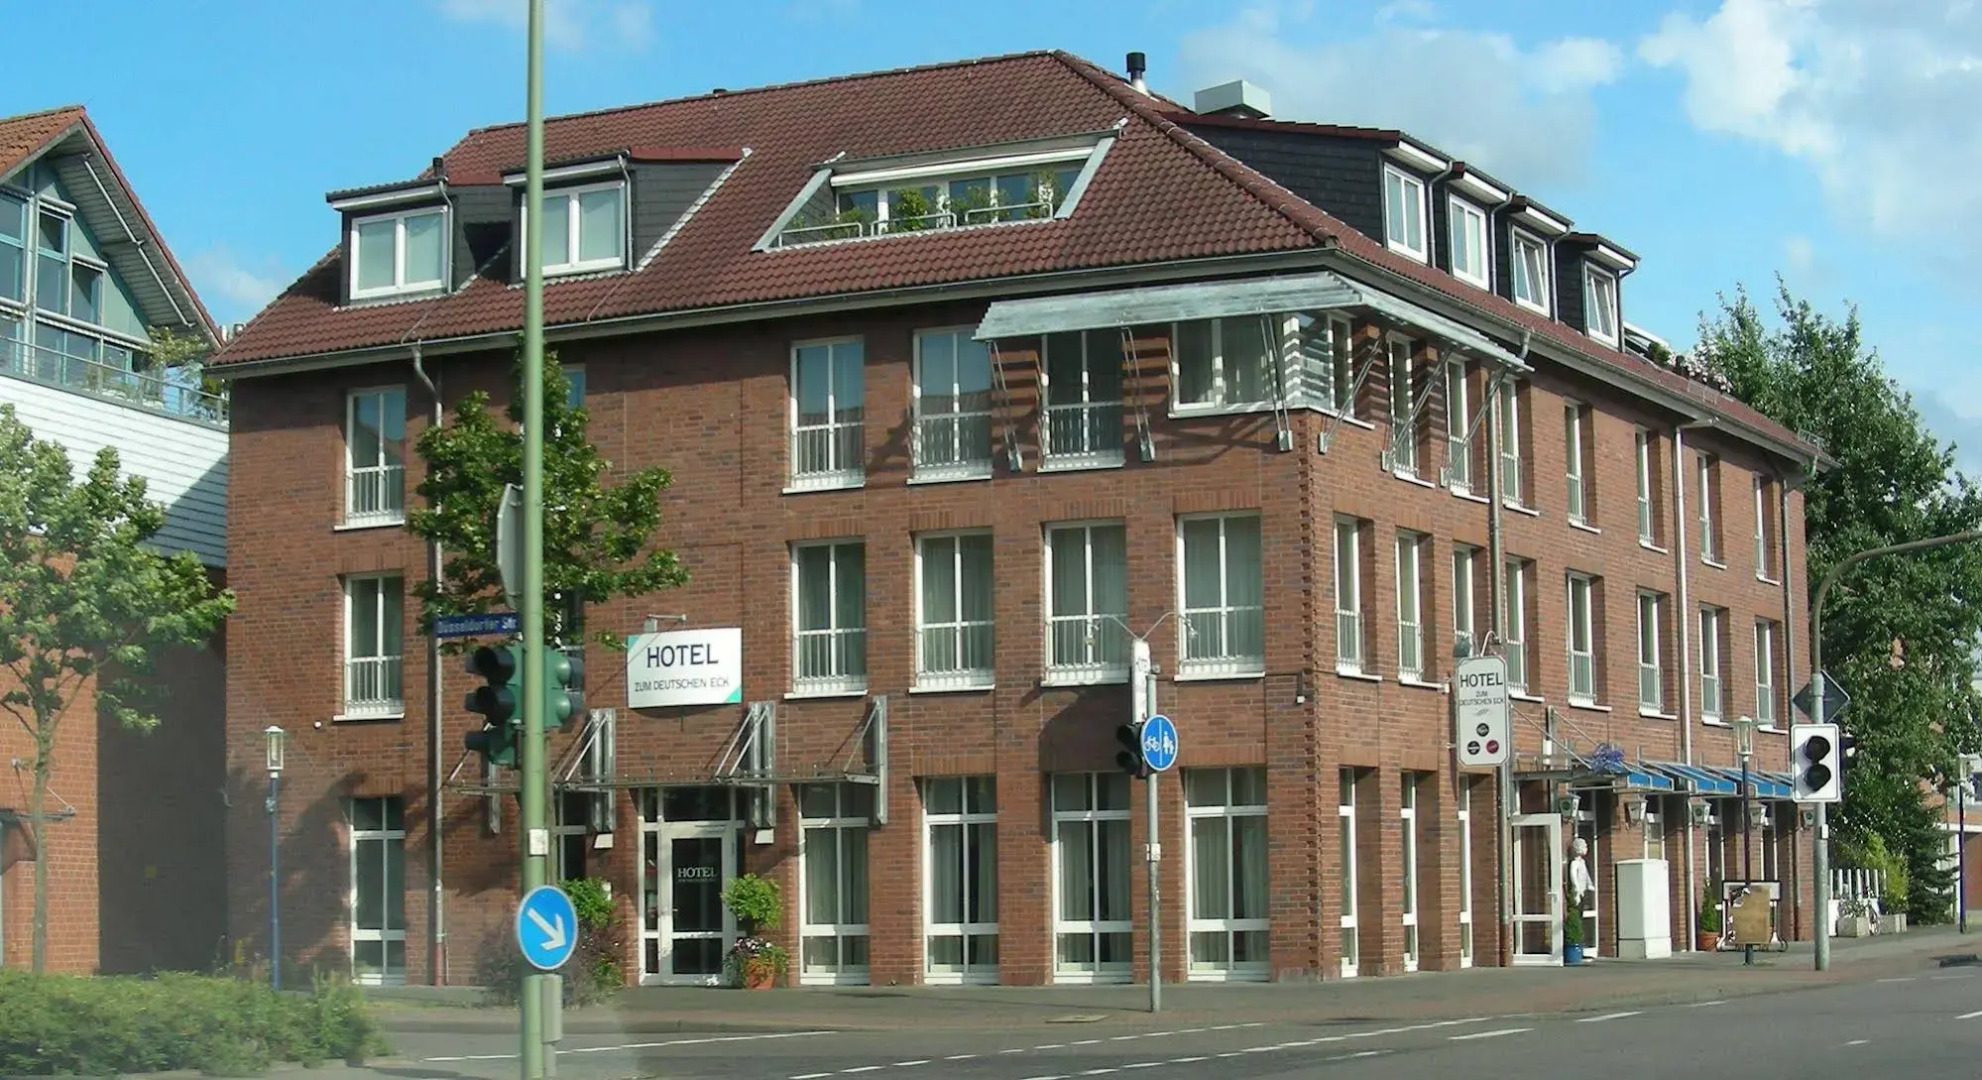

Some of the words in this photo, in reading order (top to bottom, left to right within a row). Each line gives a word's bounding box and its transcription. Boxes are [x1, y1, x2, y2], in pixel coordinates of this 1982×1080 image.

[646, 643, 719, 668] HOTEL
[634, 681, 652, 692] ZUM
[653, 678, 707, 691] DEUTSCHEN
[710, 676, 729, 688] ECK
[1460, 672, 1503, 688] HOTEL
[677, 867, 717, 878] HOTEL
